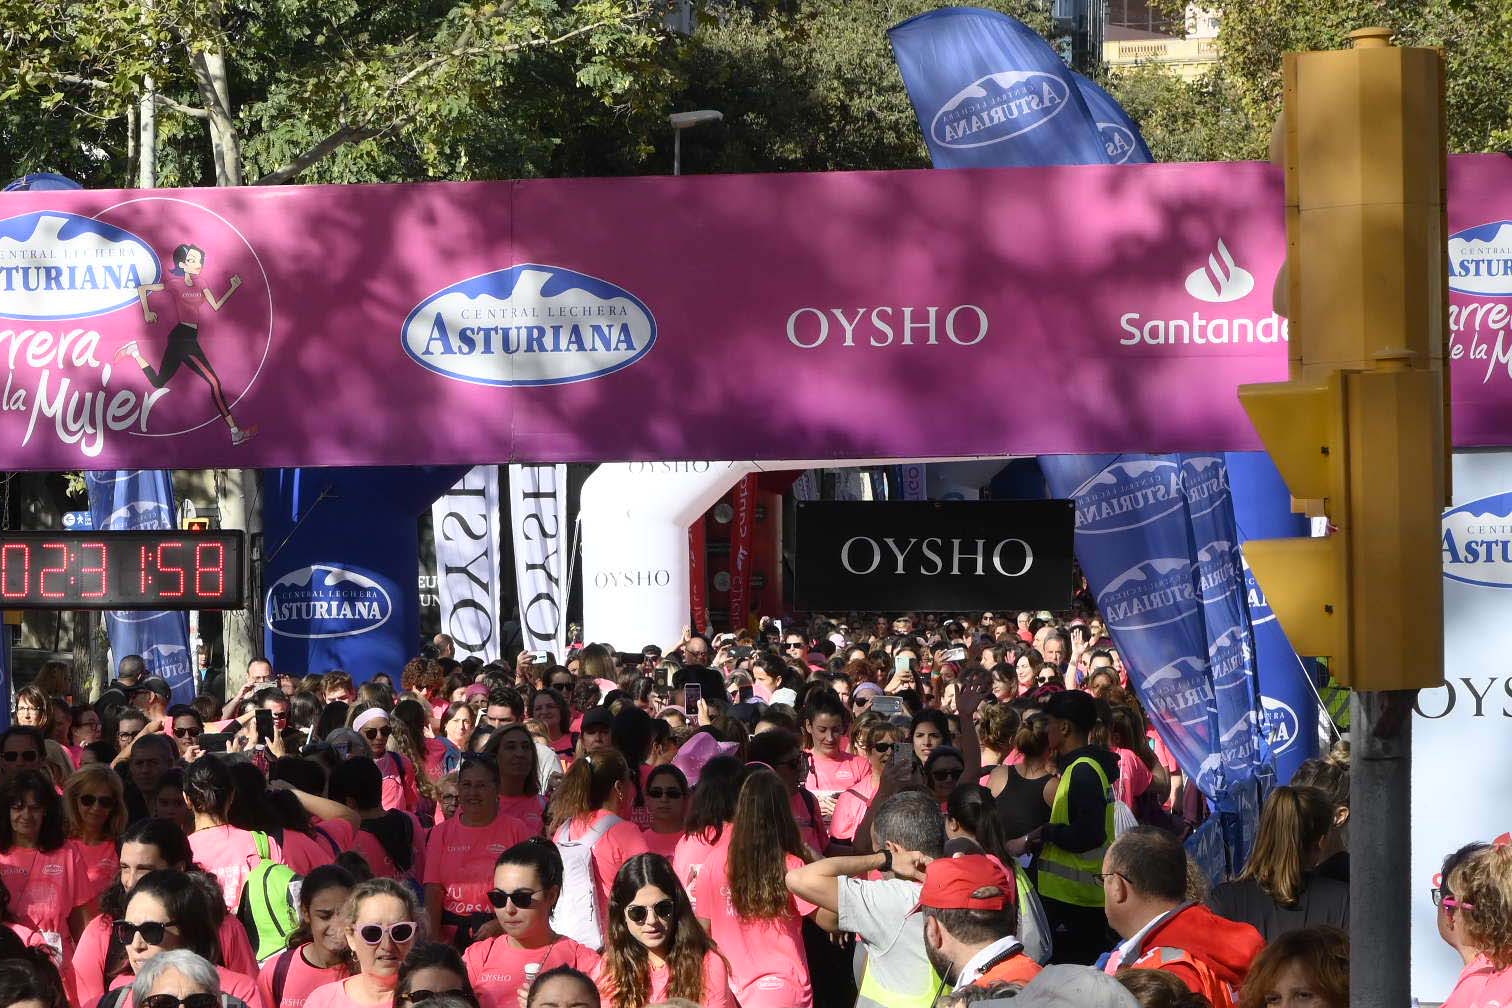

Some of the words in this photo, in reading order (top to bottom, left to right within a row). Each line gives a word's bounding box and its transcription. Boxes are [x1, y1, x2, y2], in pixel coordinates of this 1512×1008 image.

[461, 307, 539, 319] CENTRAL
[548, 305, 628, 318] LECHERA
[786, 304, 989, 348] OYSHO
[1119, 311, 1289, 346] Santande
[421, 311, 637, 356] ASTURIANA
[1469, 331, 1488, 360] la
[2, 371, 26, 412] la
[21, 363, 171, 457] Mujer
[840, 536, 1034, 577] OYSHO
[594, 569, 671, 589] OYSHO
[269, 596, 383, 623] ASTURIANA
